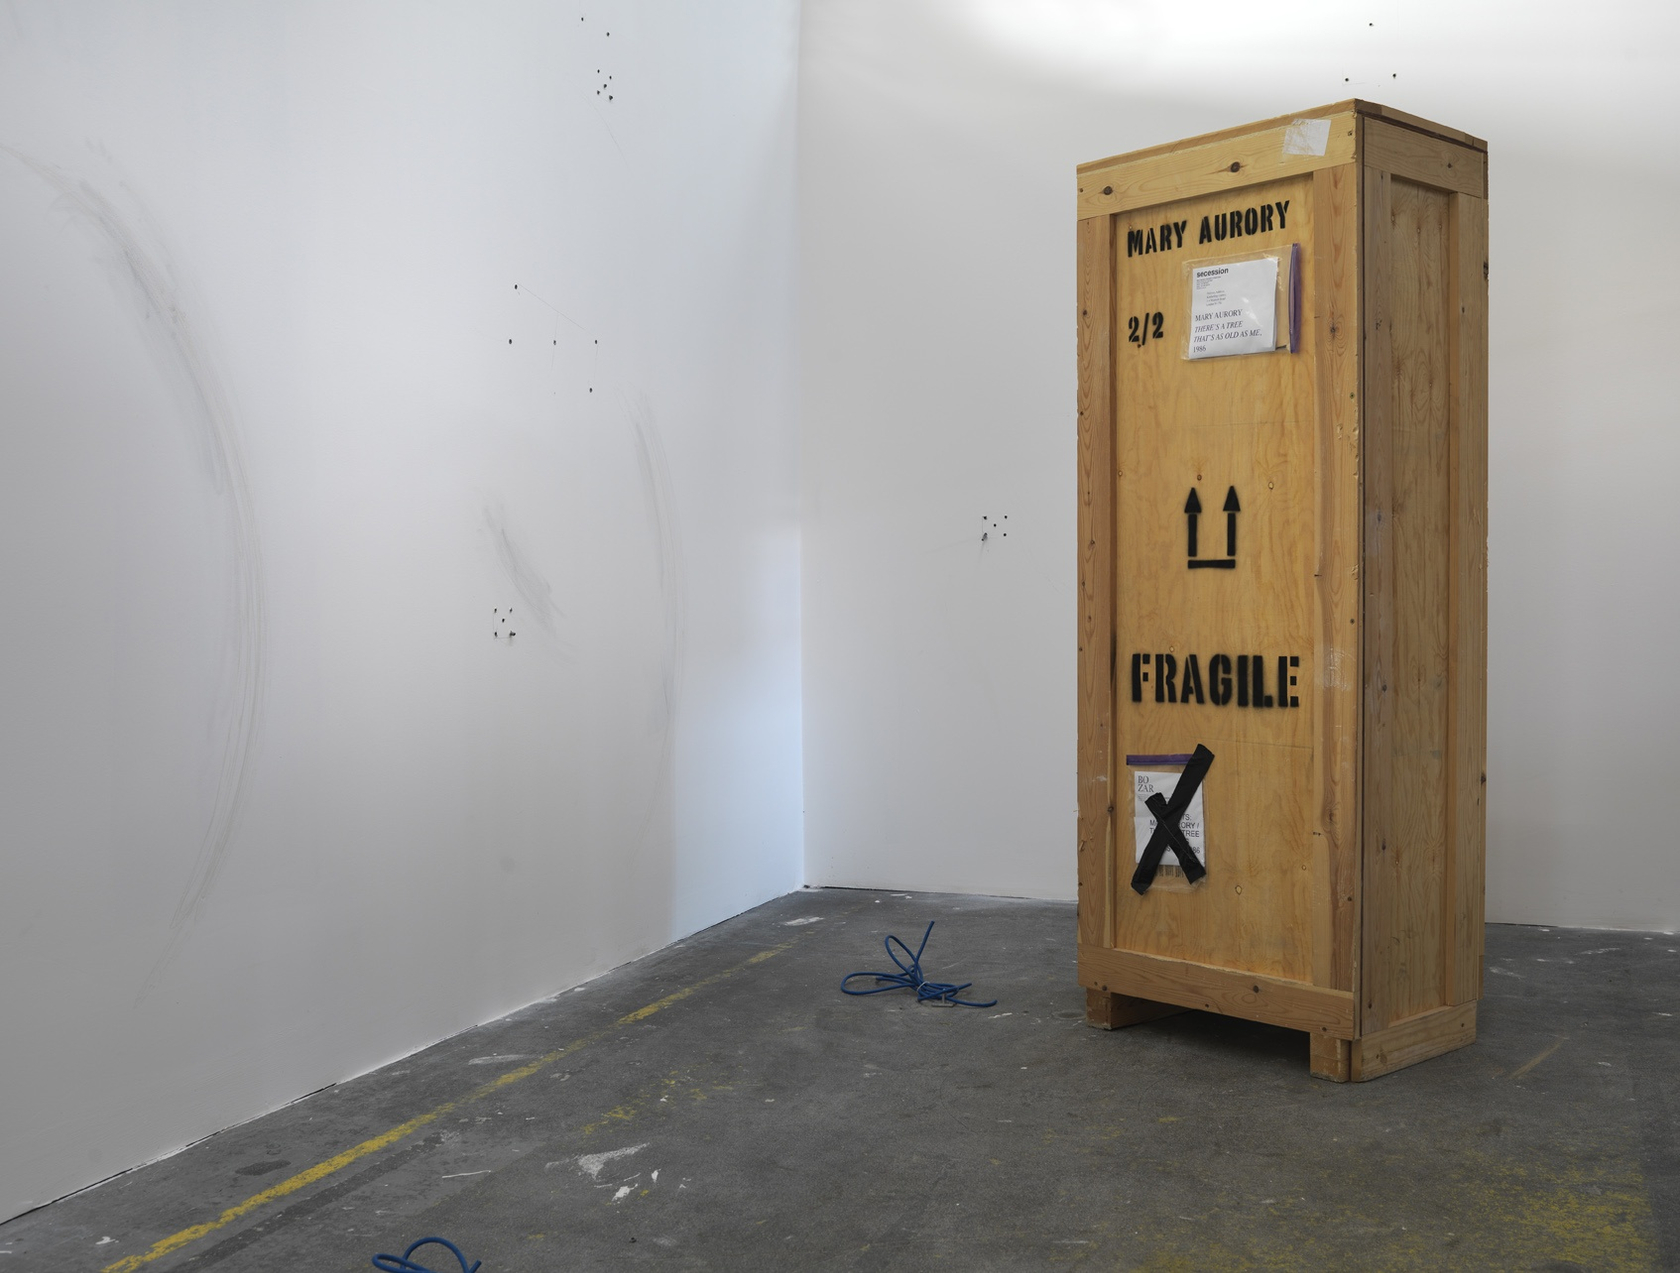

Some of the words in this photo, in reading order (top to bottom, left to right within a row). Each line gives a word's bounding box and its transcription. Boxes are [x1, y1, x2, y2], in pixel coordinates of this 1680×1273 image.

[1127, 220, 1187, 257] MARY
[1199, 200, 1290, 244] AURORY
[1196, 268, 1229, 278] secession
[1195, 312, 1213, 321] MARY
[1214, 309, 1243, 319] AURORY
[1128, 311, 1164, 346] 2/2
[1194, 323, 1219, 333] THERE'S
[1226, 320, 1243, 329] TREE
[1193, 334, 1214, 343] THAT'S
[1215, 332, 1223, 341] AS
[1224, 330, 1239, 340] OLD
[1239, 329, 1248, 338] AS
[1193, 345, 1206, 353] 1986
[1131, 653, 1300, 708] FRAGILE
[1137, 775, 1149, 784] BO
[1137, 784, 1154, 793] ZAR
